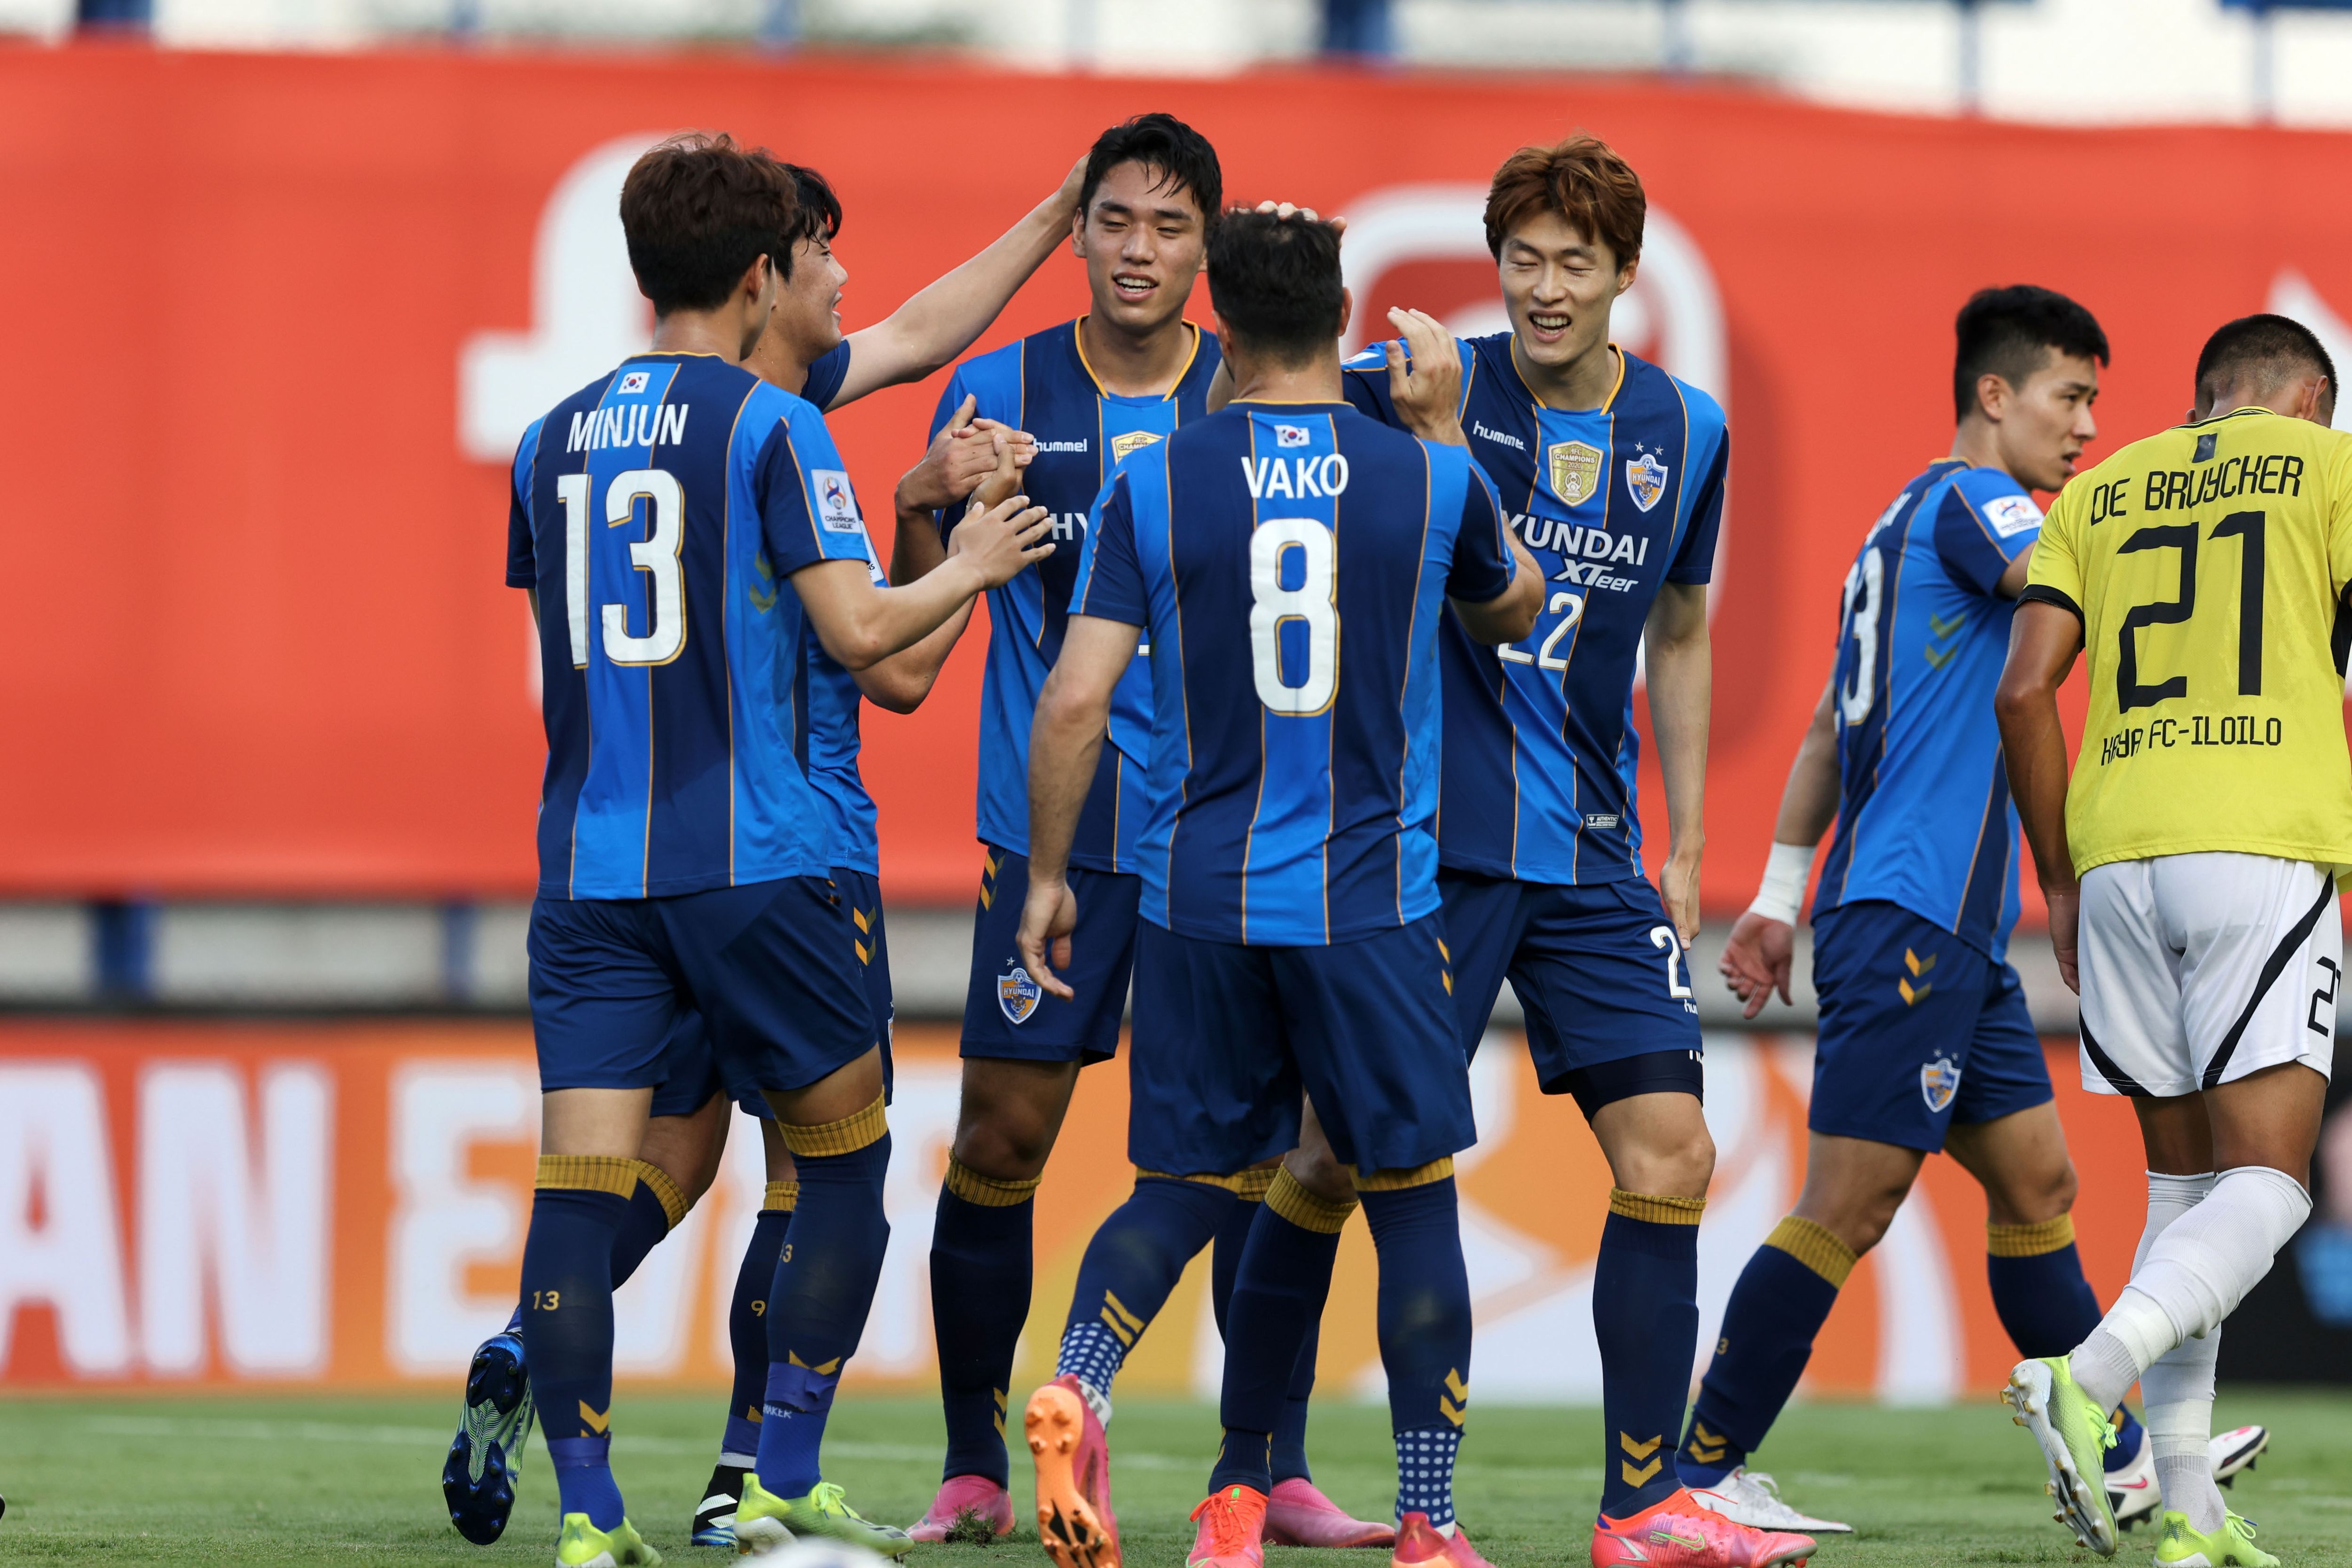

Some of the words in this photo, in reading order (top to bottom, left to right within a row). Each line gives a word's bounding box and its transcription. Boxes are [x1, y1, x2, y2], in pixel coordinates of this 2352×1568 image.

[566, 404, 689, 453] MINJUN
[1034, 438, 1087, 452] hummel
[1555, 454, 1595, 463] CHAMPIONS
[1241, 453, 1349, 499] VAKO
[1632, 472, 1660, 486] HYUNDAI
[2091, 478, 2130, 526] DE
[2145, 455, 2304, 511] BRUYCKER
[557, 469, 686, 669] 13
[1553, 558, 1639, 592] XTeer
[1249, 518, 1341, 716] 8
[2117, 510, 2266, 714] 21
[1834, 547, 1882, 733] 3
[2148, 716, 2281, 749] FC-ILOILO
[1004, 987, 1034, 997] HYUNDAI
[533, 1290, 560, 1311] 13
[751, 1300, 766, 1317] 9
